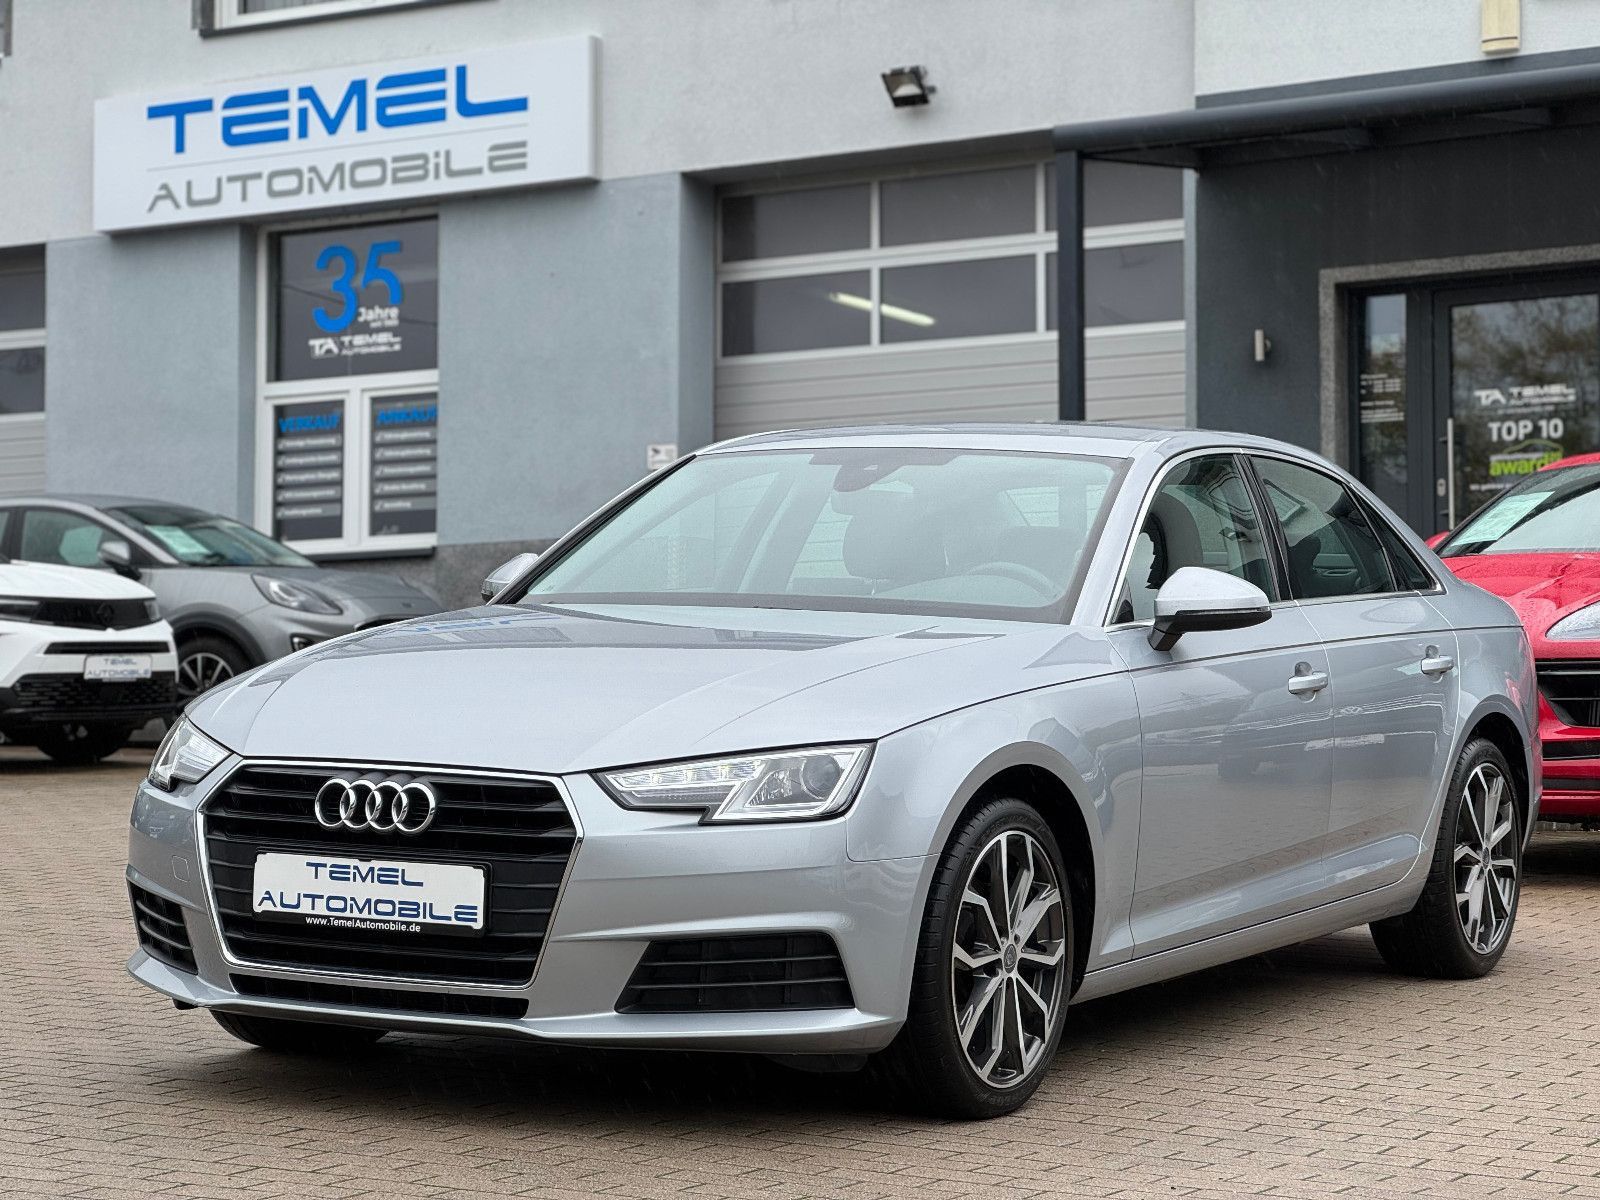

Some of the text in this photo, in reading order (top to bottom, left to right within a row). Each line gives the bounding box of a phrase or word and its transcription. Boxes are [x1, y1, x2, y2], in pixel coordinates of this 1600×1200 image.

[147, 65, 528, 154] TEMEL
[312, 240, 402, 333] 35
[357, 305, 399, 322] Jahre
[341, 331, 401, 347] TEMEL
[1509, 383, 1576, 398] TEMEL
[278, 412, 341, 433] VERKAUF
[1488, 417, 1564, 443] TOP 10
[305, 861, 424, 887] TEMEL
[257, 890, 478, 923] AUTOMOBILE
[305, 915, 421, 933] www.TemelAutomobile.de
